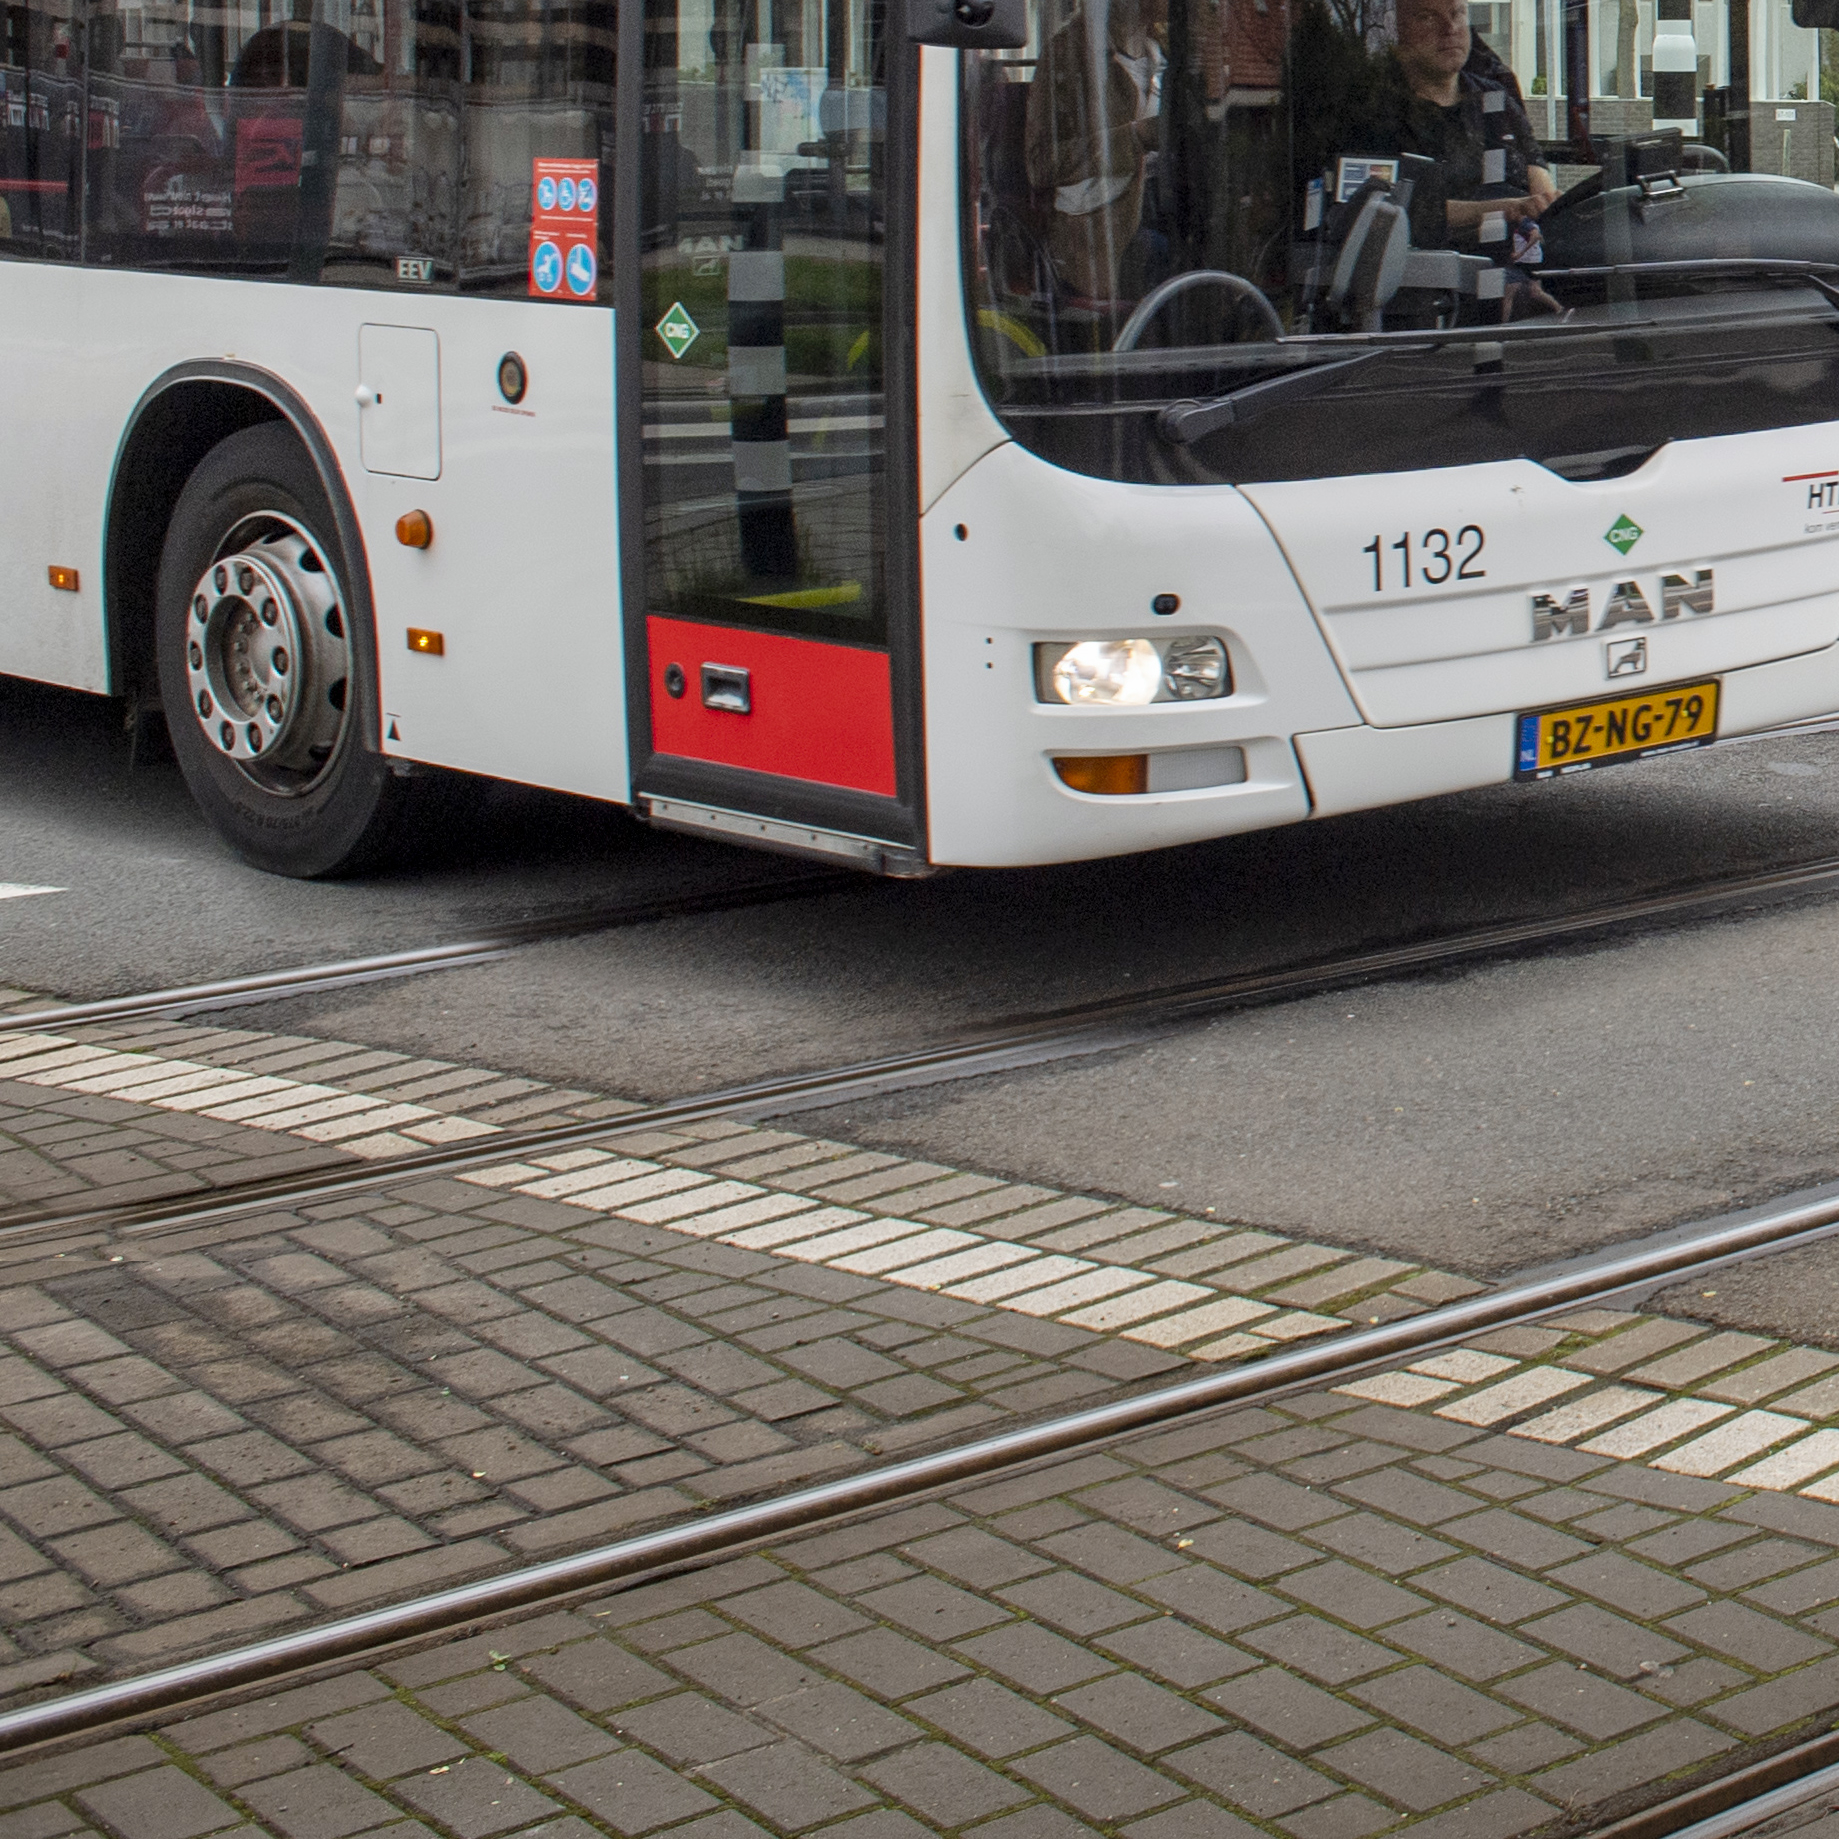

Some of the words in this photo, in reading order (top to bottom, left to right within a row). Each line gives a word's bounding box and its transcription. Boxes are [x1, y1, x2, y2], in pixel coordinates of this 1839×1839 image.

[397, 259, 433, 280] EEV
[1362, 523, 1487, 592] 1132
[1609, 526, 1639, 544] CNG
[1529, 567, 1714, 643] MAN
[1551, 694, 1704, 758] BZ-NG-79
